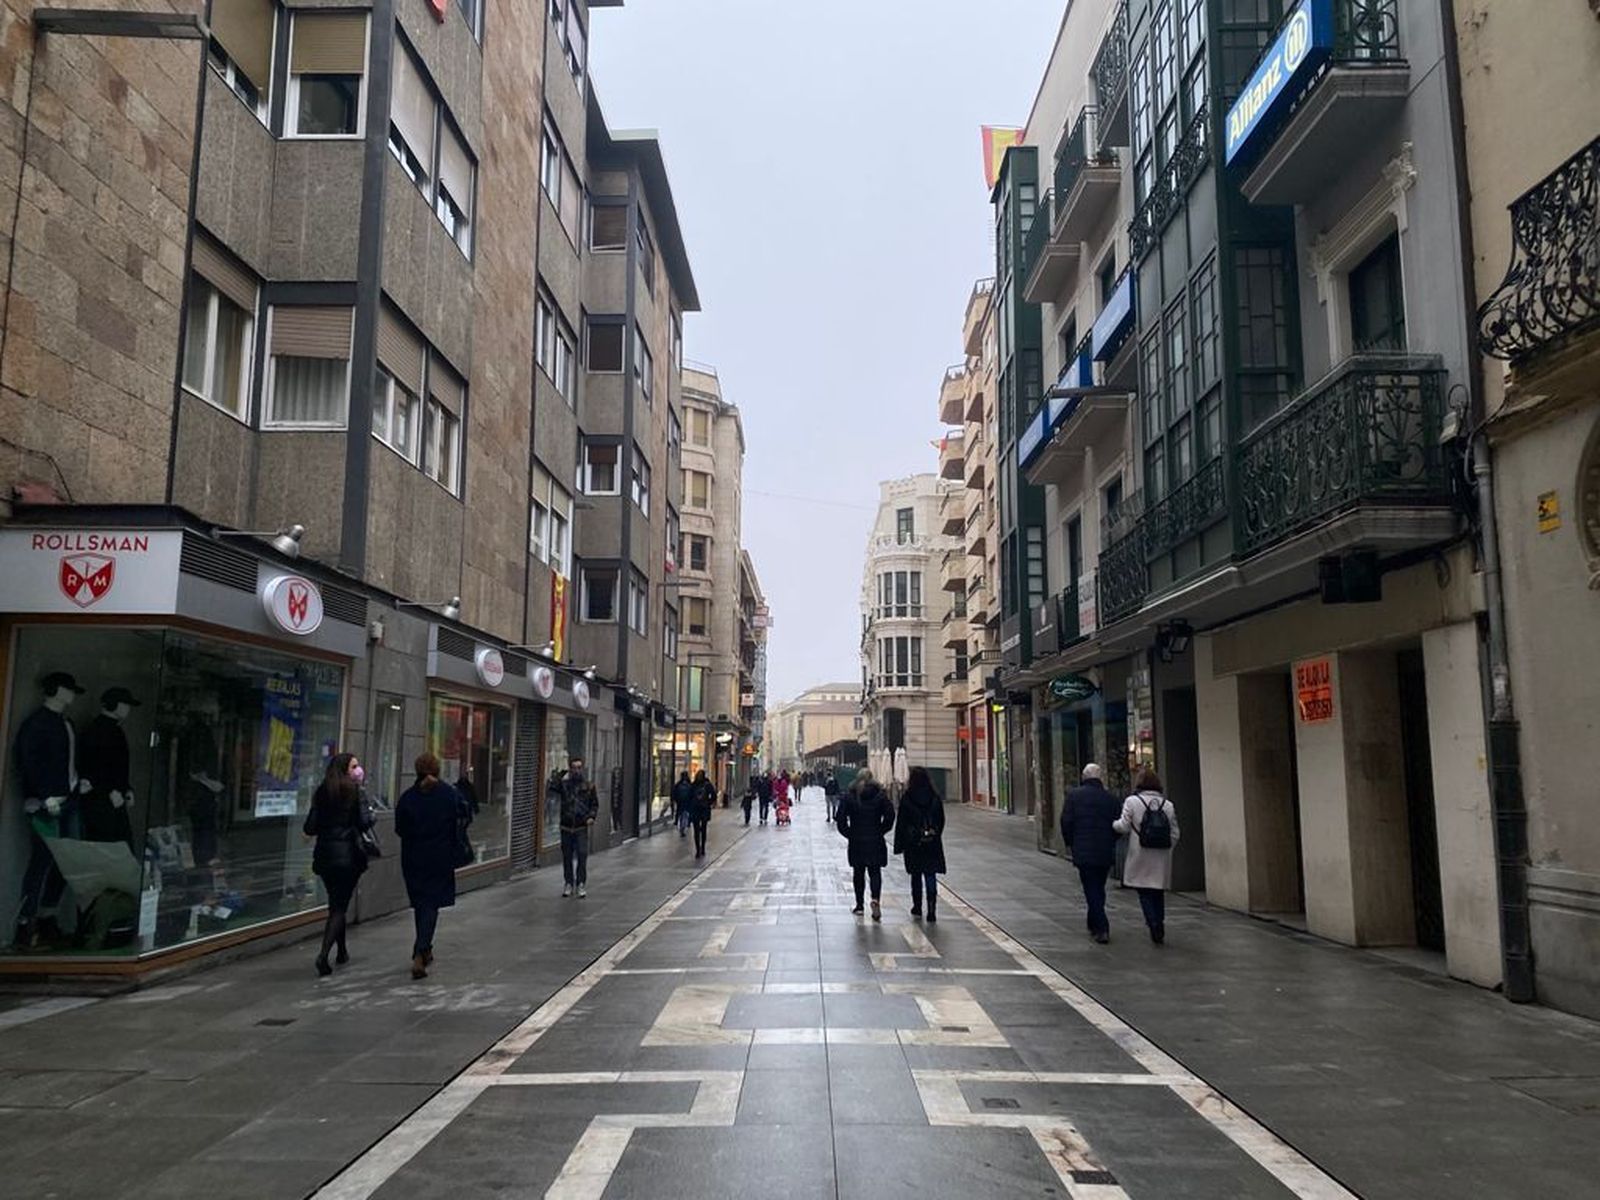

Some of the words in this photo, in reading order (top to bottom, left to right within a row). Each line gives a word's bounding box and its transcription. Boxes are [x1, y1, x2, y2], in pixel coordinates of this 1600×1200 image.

[1229, 55, 1282, 147] Allianz
[32, 533, 149, 553] ROLLSMAN
[67, 573, 78, 587] R
[93, 575, 108, 587] M
